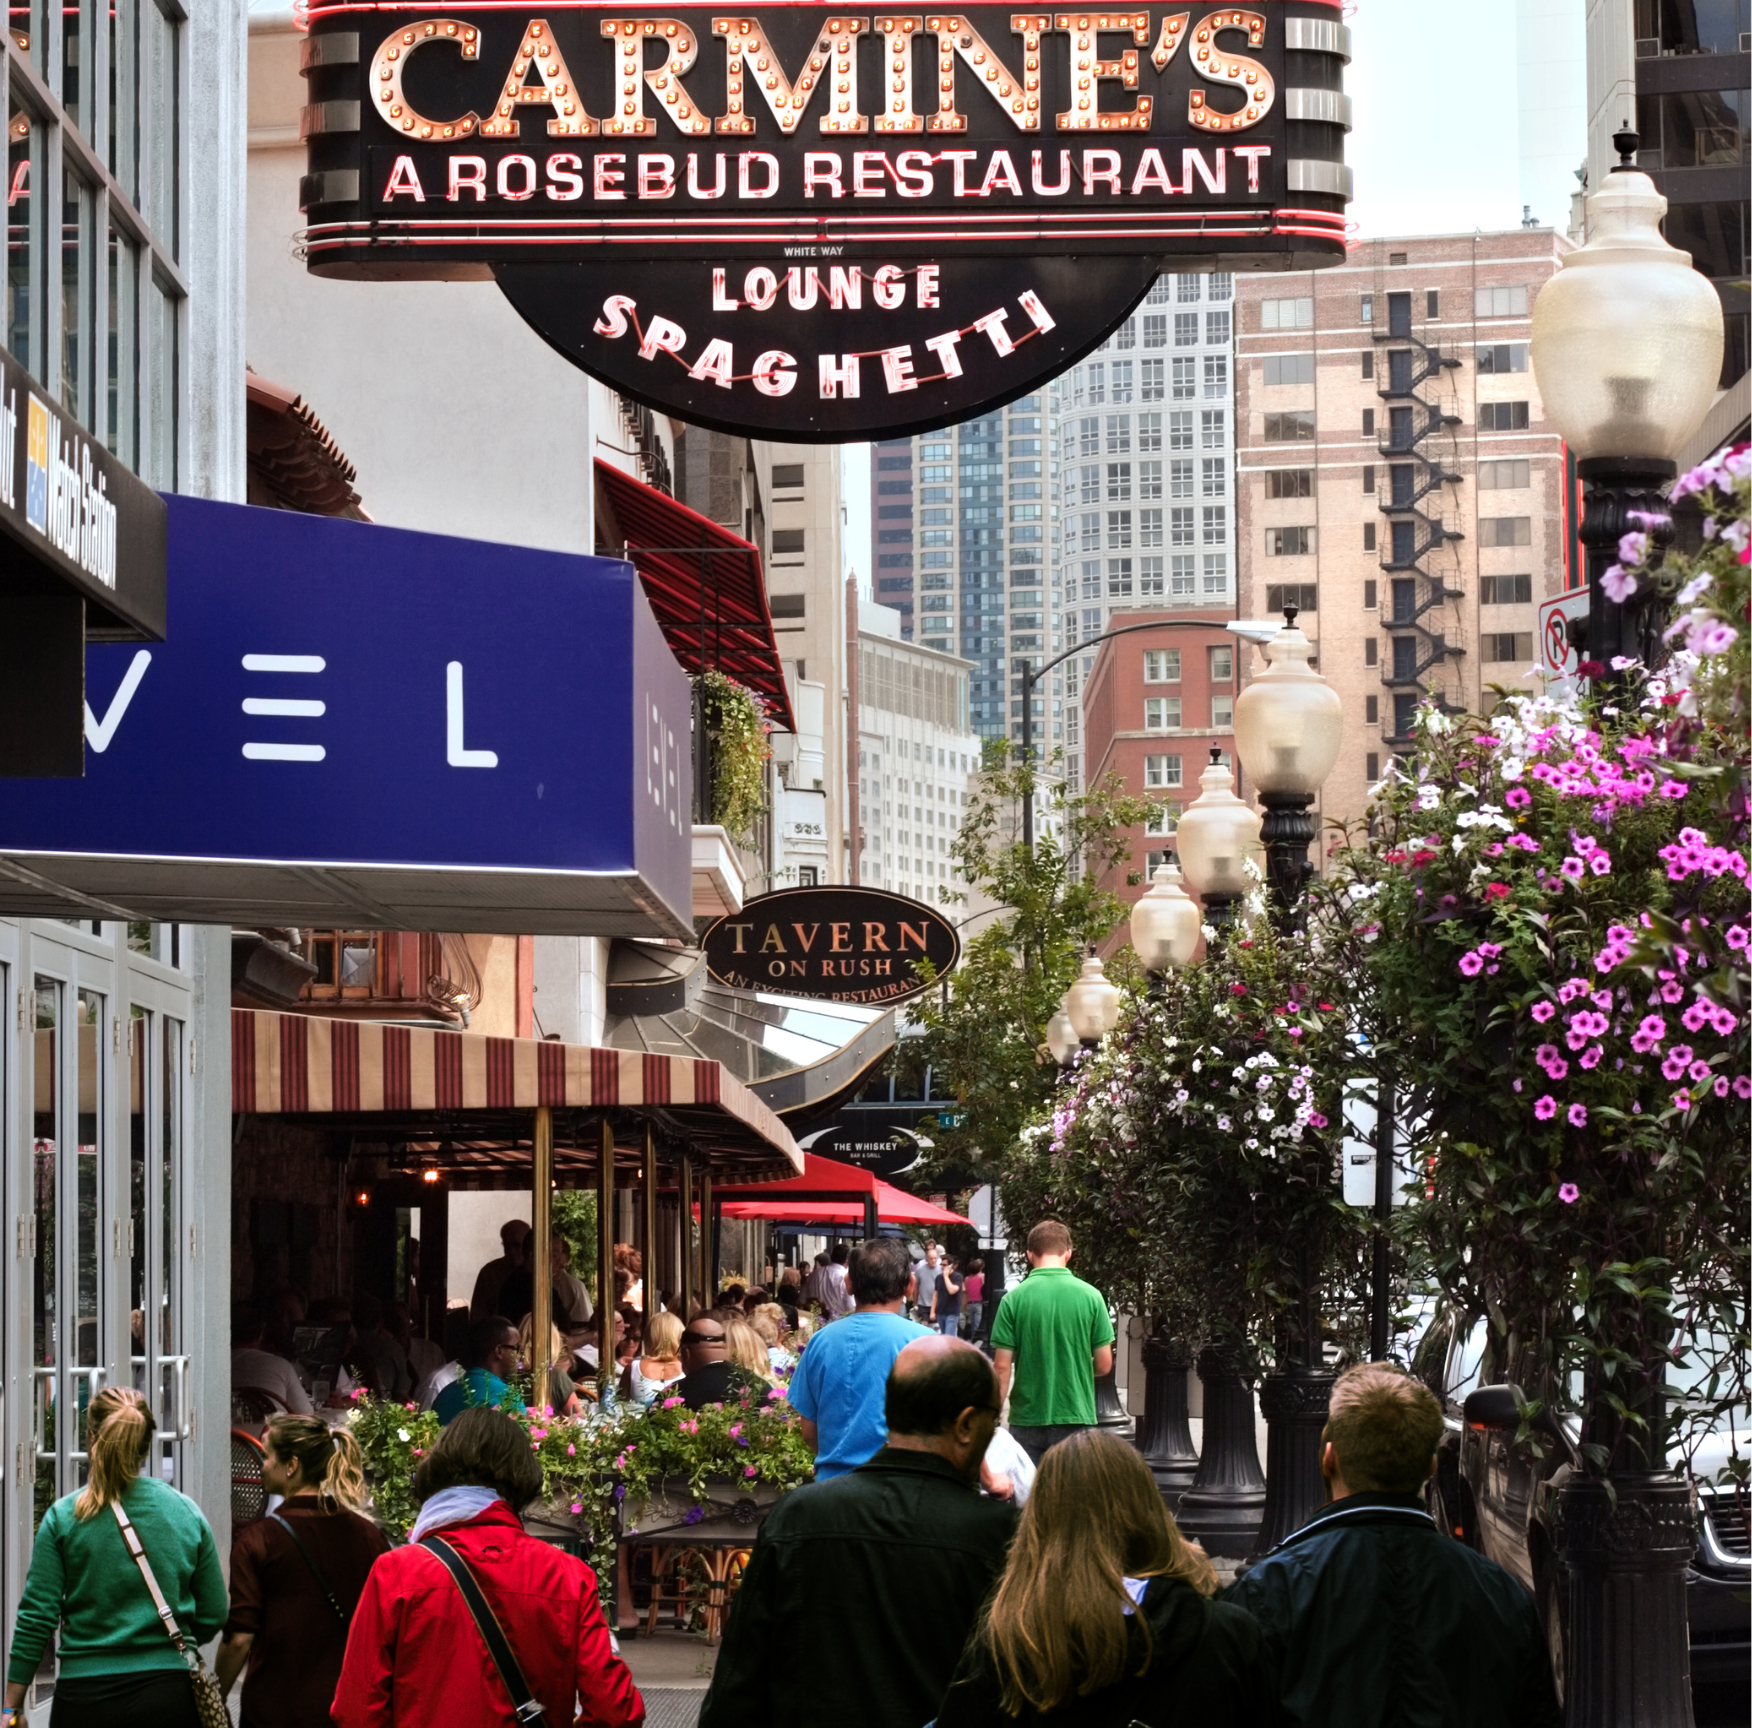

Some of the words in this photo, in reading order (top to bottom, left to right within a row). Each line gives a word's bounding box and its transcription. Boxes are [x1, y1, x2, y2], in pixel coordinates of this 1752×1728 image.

[368, 9, 1276, 142] CARMINE'S
[383, 155, 426, 202] A
[448, 152, 780, 201] ROSEBUD
[803, 146, 1271, 198] RESTAURANT
[784, 247, 817, 257] WHITE
[821, 246, 844, 256] WAY
[713, 265, 940, 311] LOUNGE
[593, 289, 1056, 399] SPAGHETTI
[48, 410, 80, 564] Watch
[81, 443, 117, 591] Station
[725, 921, 930, 954] TAVERN
[724, 970, 748, 989] AN
[832, 973, 921, 1004] RESTAURAN
[768, 960, 807, 977] ON
[821, 958, 892, 976] RUSH
[833, 1143, 852, 1151] THE
[855, 1142, 898, 1151] WHISKEY
